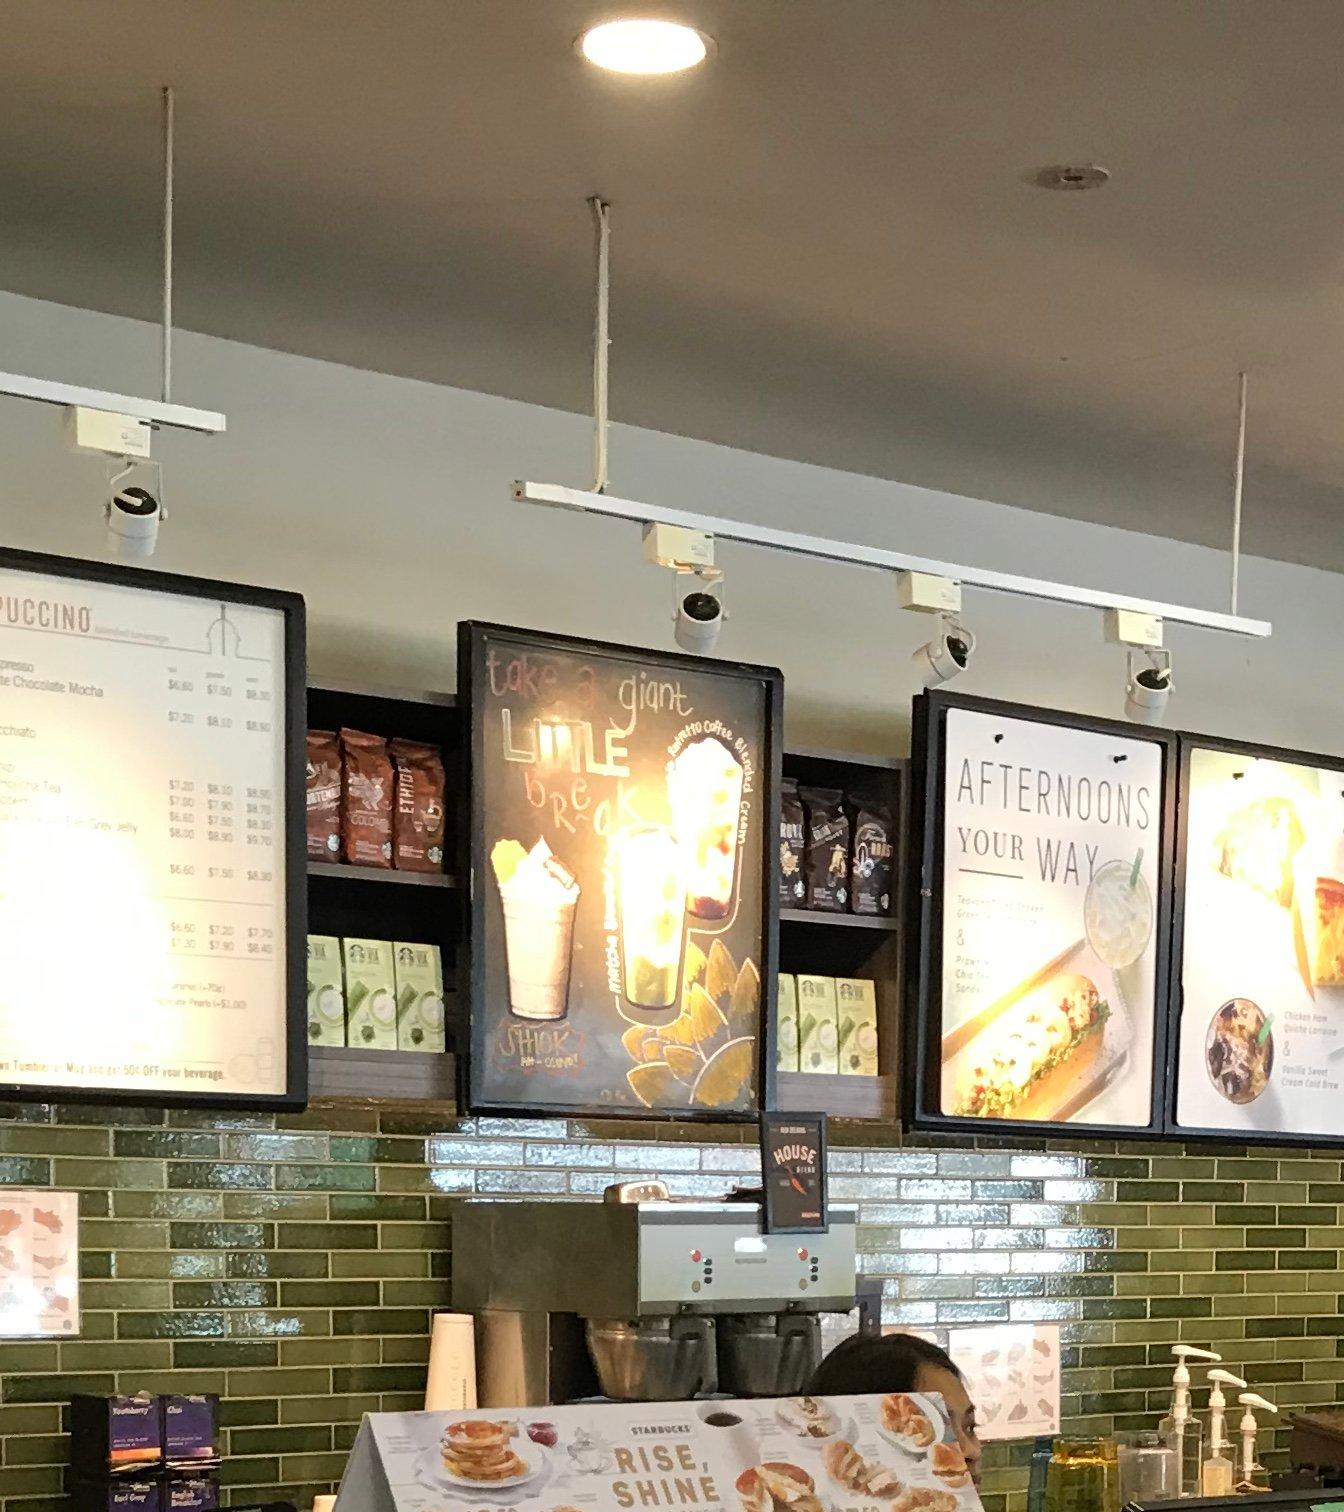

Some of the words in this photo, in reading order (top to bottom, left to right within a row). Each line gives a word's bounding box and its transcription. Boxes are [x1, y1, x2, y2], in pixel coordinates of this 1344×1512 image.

[12, 675, 66, 694] Chocolate
[68, 681, 104, 699] Mocha
[485, 649, 557, 699] take
[610, 671, 694, 737] giant
[957, 756, 1151, 831] AFTERNOONS
[957, 827, 1025, 862] YOUR
[1036, 836, 1100, 887] WAY
[162, 1066, 182, 1081] your
[773, 1144, 817, 1166] HOUSE
[630, 1423, 692, 1437] STARBUCKS
[613, 1442, 710, 1475] RISE,
[113, 1493, 128, 1504] Earl
[129, 1493, 147, 1505] Grey
[611, 1476, 722, 1508] SHINE
